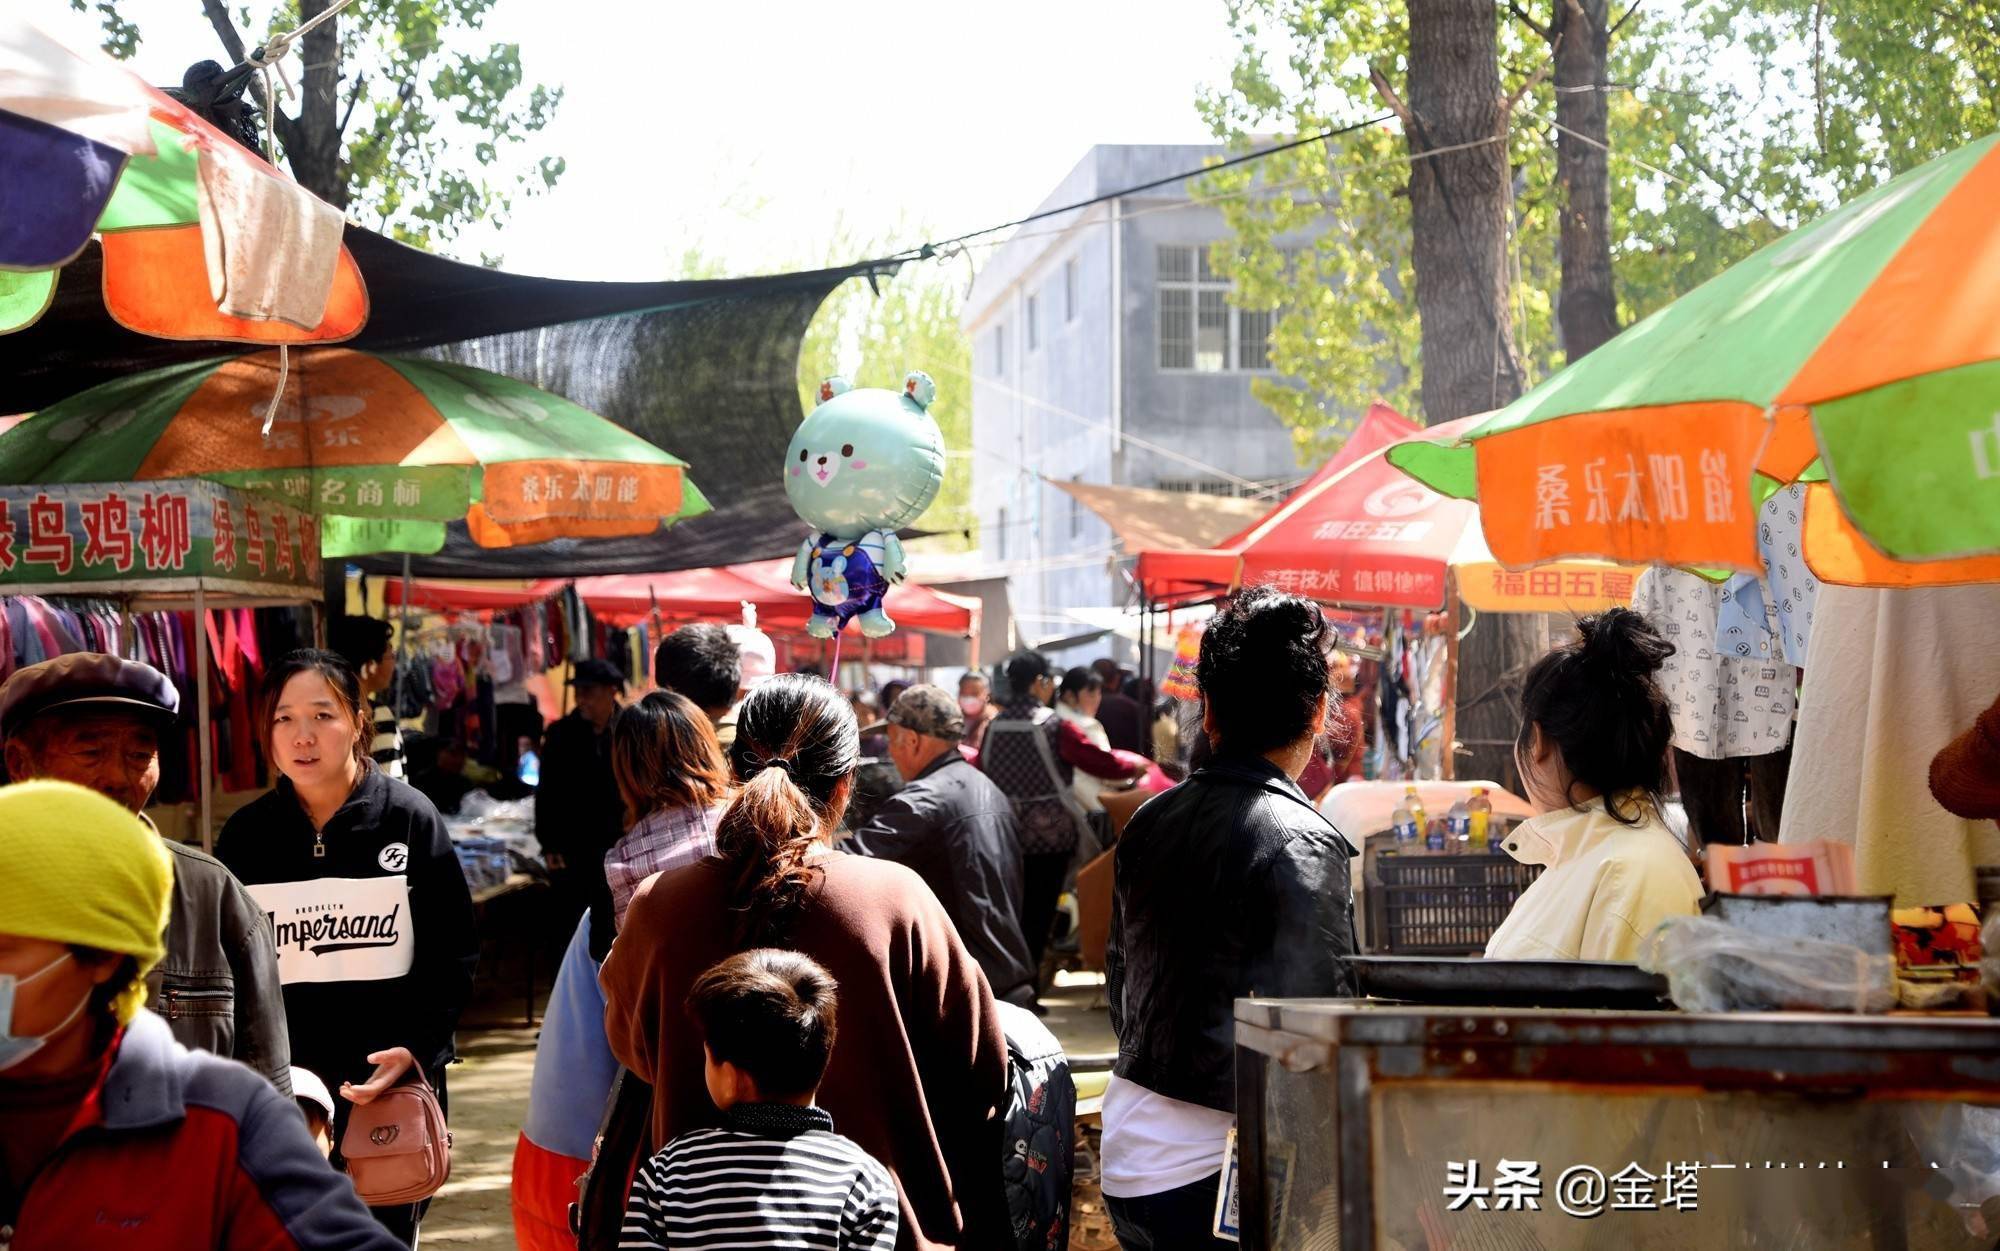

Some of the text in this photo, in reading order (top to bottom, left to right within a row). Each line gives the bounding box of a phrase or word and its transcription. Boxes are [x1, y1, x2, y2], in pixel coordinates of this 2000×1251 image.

[245, 476, 421, 507] 驰名商标
[521, 474, 640, 503] 桑乐太阳能
[1535, 448, 1736, 530] 桑乐太阳能
[1493, 569, 1634, 601] 福田五星
[295, 903, 344, 915] BROOKLYN
